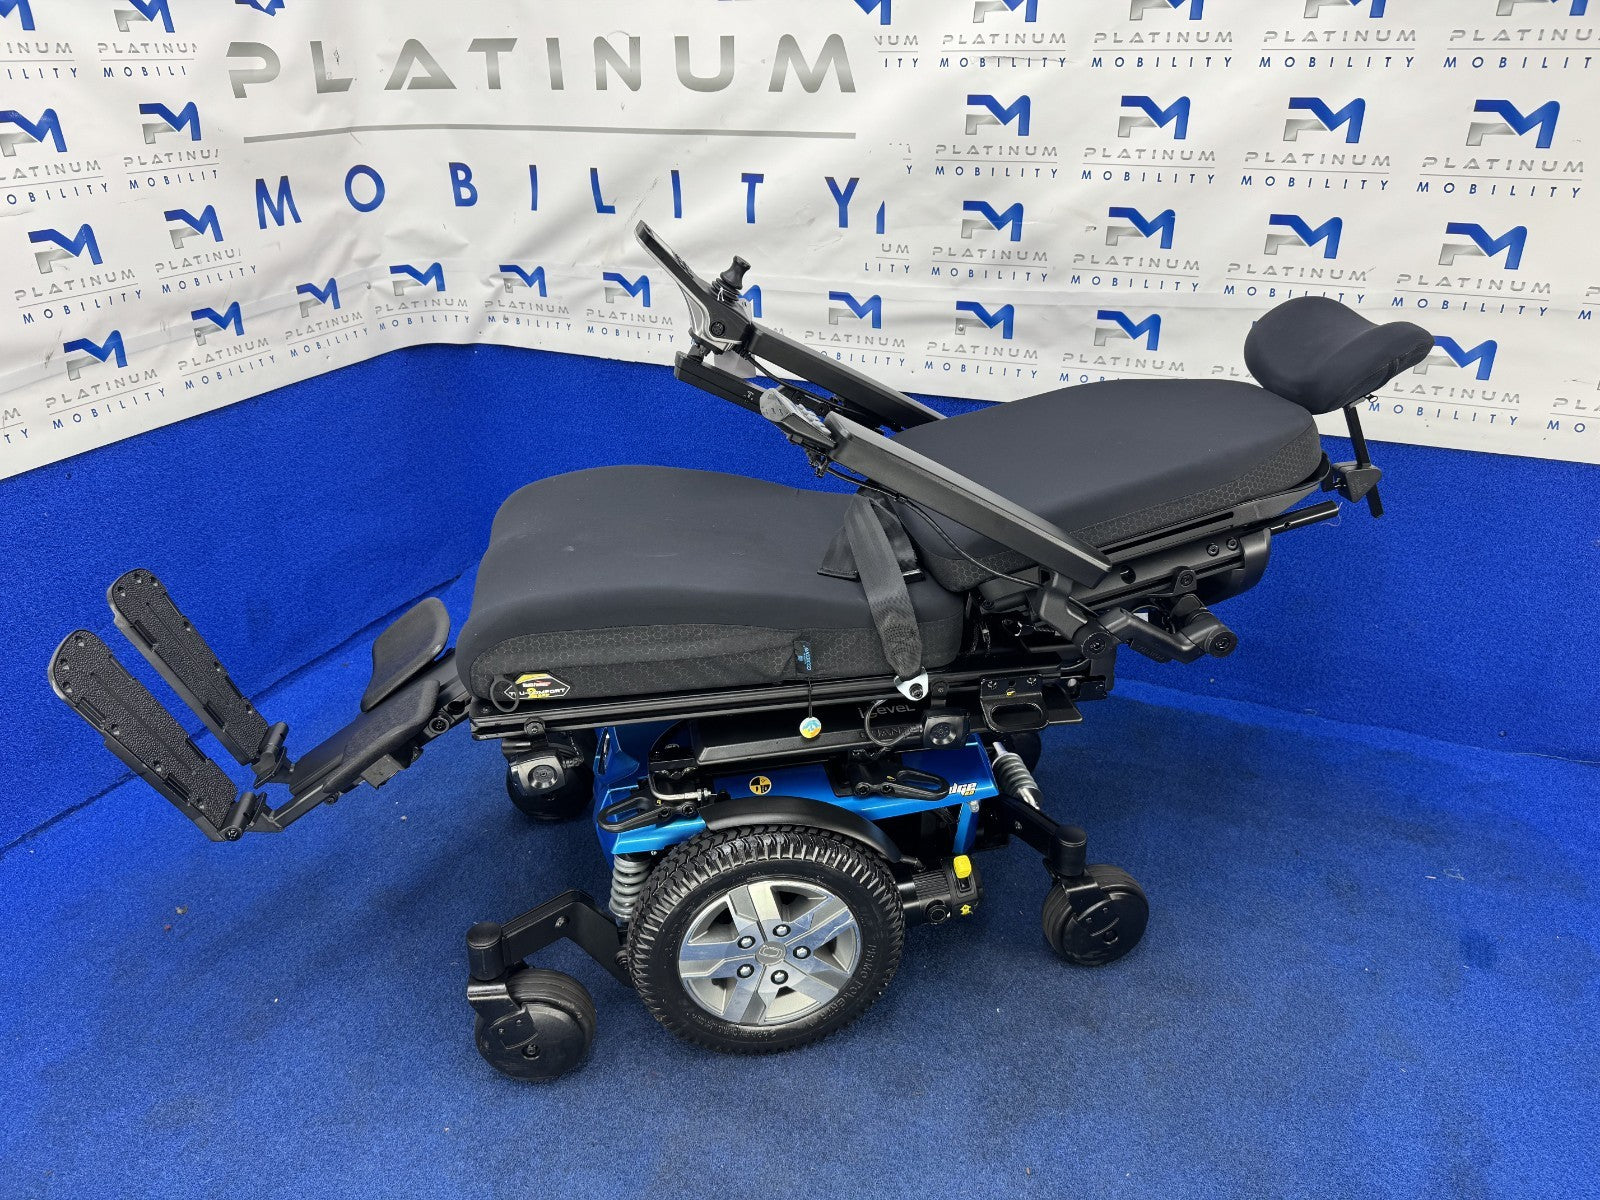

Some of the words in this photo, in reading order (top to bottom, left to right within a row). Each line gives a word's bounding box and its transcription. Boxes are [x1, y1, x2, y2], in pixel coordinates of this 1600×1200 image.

[942, 33, 1066, 45] PLATINUM
[1094, 31, 1233, 44] PLATINUM
[1263, 29, 1416, 42] PLATINUM
[226, 33, 857, 98] PLATINUM
[939, 57, 1068, 68] MOBILITY
[1091, 56, 1233, 69] MOBILITY
[1258, 56, 1415, 69] MOBILITY
[935, 145, 1058, 156] PLATINUM
[1083, 146, 1215, 162] PLATINUM
[1244, 151, 1391, 167] PLATINUM
[935, 165, 1058, 179] MOBILITY
[1421, 156, 1584, 173] PLATINUM
[1081, 169, 1215, 185] MOBILITY
[1241, 175, 1389, 191] MOBILITY
[255, 161, 860, 229] MOBILITY
[1416, 181, 1581, 200] MOBILITY
[932, 246, 1048, 262] PLATINUM
[1073, 253, 1200, 271] PLATINUM
[162, 265, 258, 294] MOBILITY
[931, 266, 1049, 283] MOBILITY
[1227, 263, 1367, 281] PLATINUM
[15, 268, 136, 302] PLATINUM
[1071, 274, 1199, 292] MOBILITY
[1397, 274, 1551, 293] PLATINUM
[23, 289, 143, 325] MOBILITY
[375, 298, 469, 314] PLATINUM
[484, 300, 571, 315] PLATINUM
[1392, 297, 1548, 316] MOBILITY
[285, 312, 363, 340] PLATINUM
[379, 314, 470, 331] MOBILITY
[487, 314, 572, 332] MOBILITY
[586, 308, 673, 326] PLATINUM
[290, 328, 369, 358] MOBILITY
[586, 325, 675, 343] MOBILITY
[804, 331, 906, 348] PLATINUM
[178, 337, 269, 370] PLATINUM
[820, 350, 906, 367] OBILITY
[926, 341, 1039, 359] PLATINUM
[925, 360, 1037, 378] MOBILITY
[1062, 352, 1185, 372] PLATINUM
[185, 355, 276, 390] MOBILITY
[45, 368, 158, 409] PLATINUM
[1393, 382, 1520, 404] LATINUM
[53, 387, 165, 429] MOBILITY
[1368, 402, 1518, 425] MOBILITY
